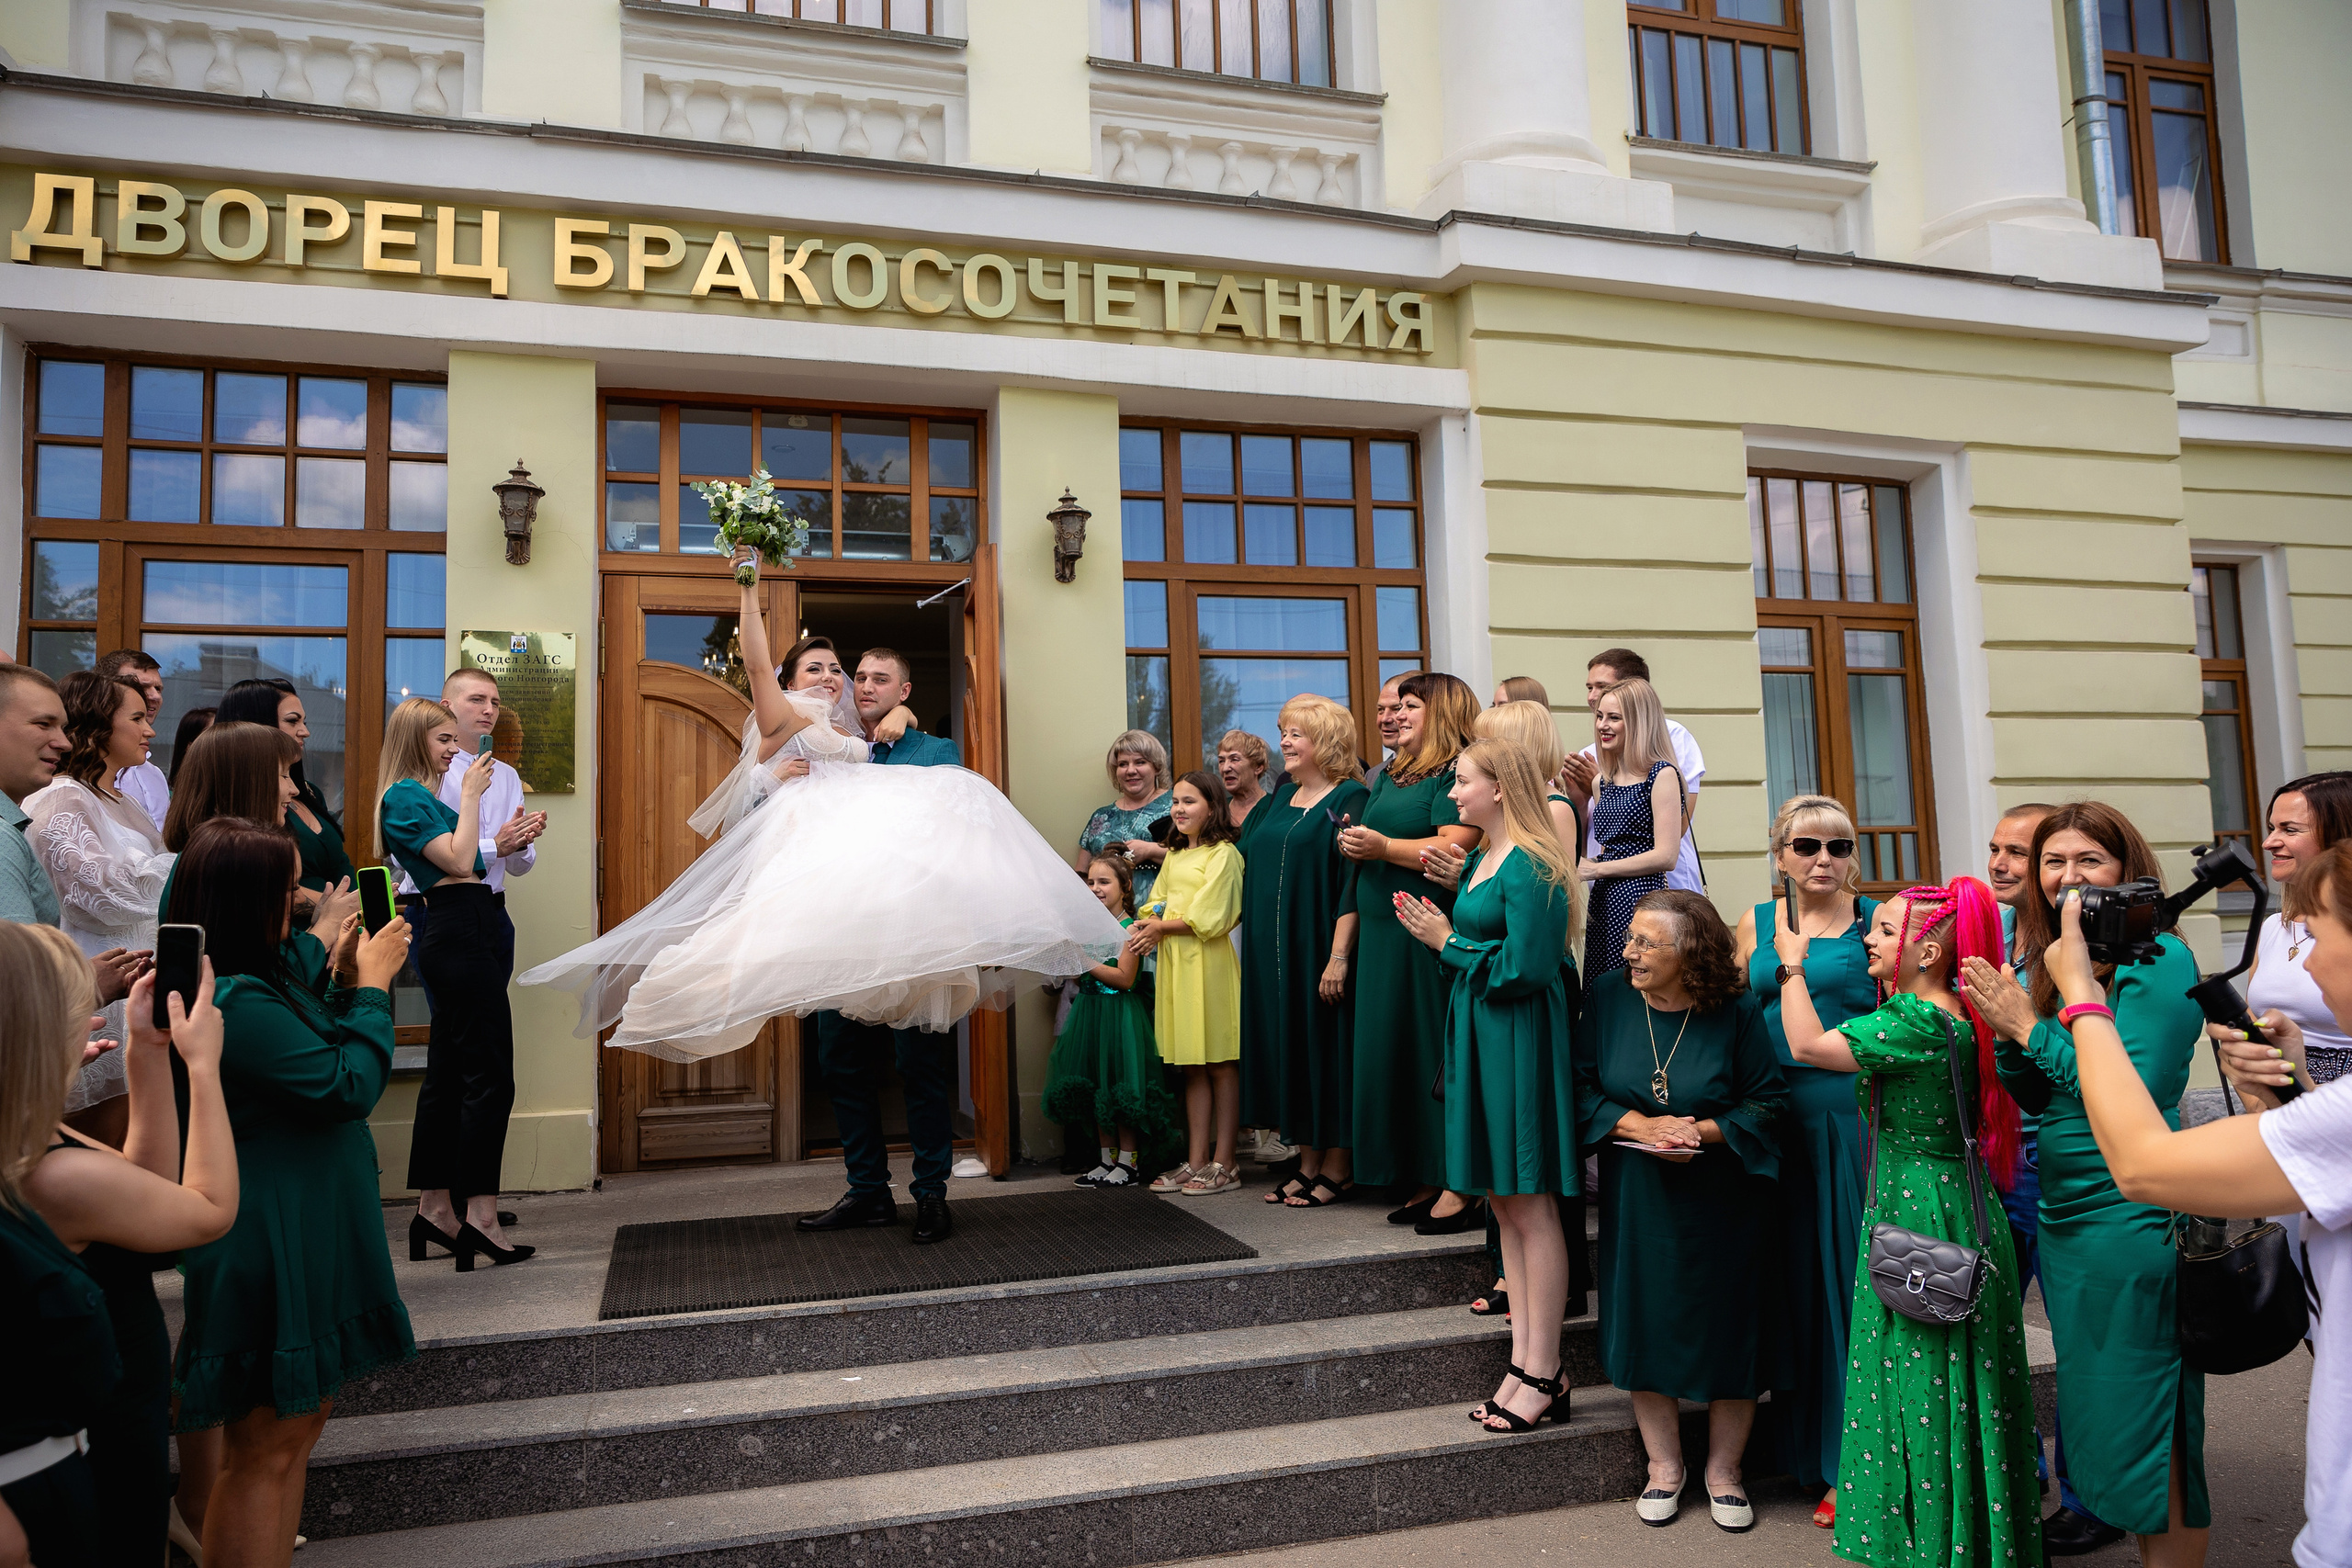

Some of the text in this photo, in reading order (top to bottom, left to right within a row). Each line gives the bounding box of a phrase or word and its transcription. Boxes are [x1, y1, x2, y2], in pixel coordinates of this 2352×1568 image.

[11, 173, 1434, 355] ДВОРЕЦ БРАКОСОЧЕТАНИЯ
[477, 653, 561, 665] Отдел ЗАГС
[516, 674, 570, 684] Новгорода
